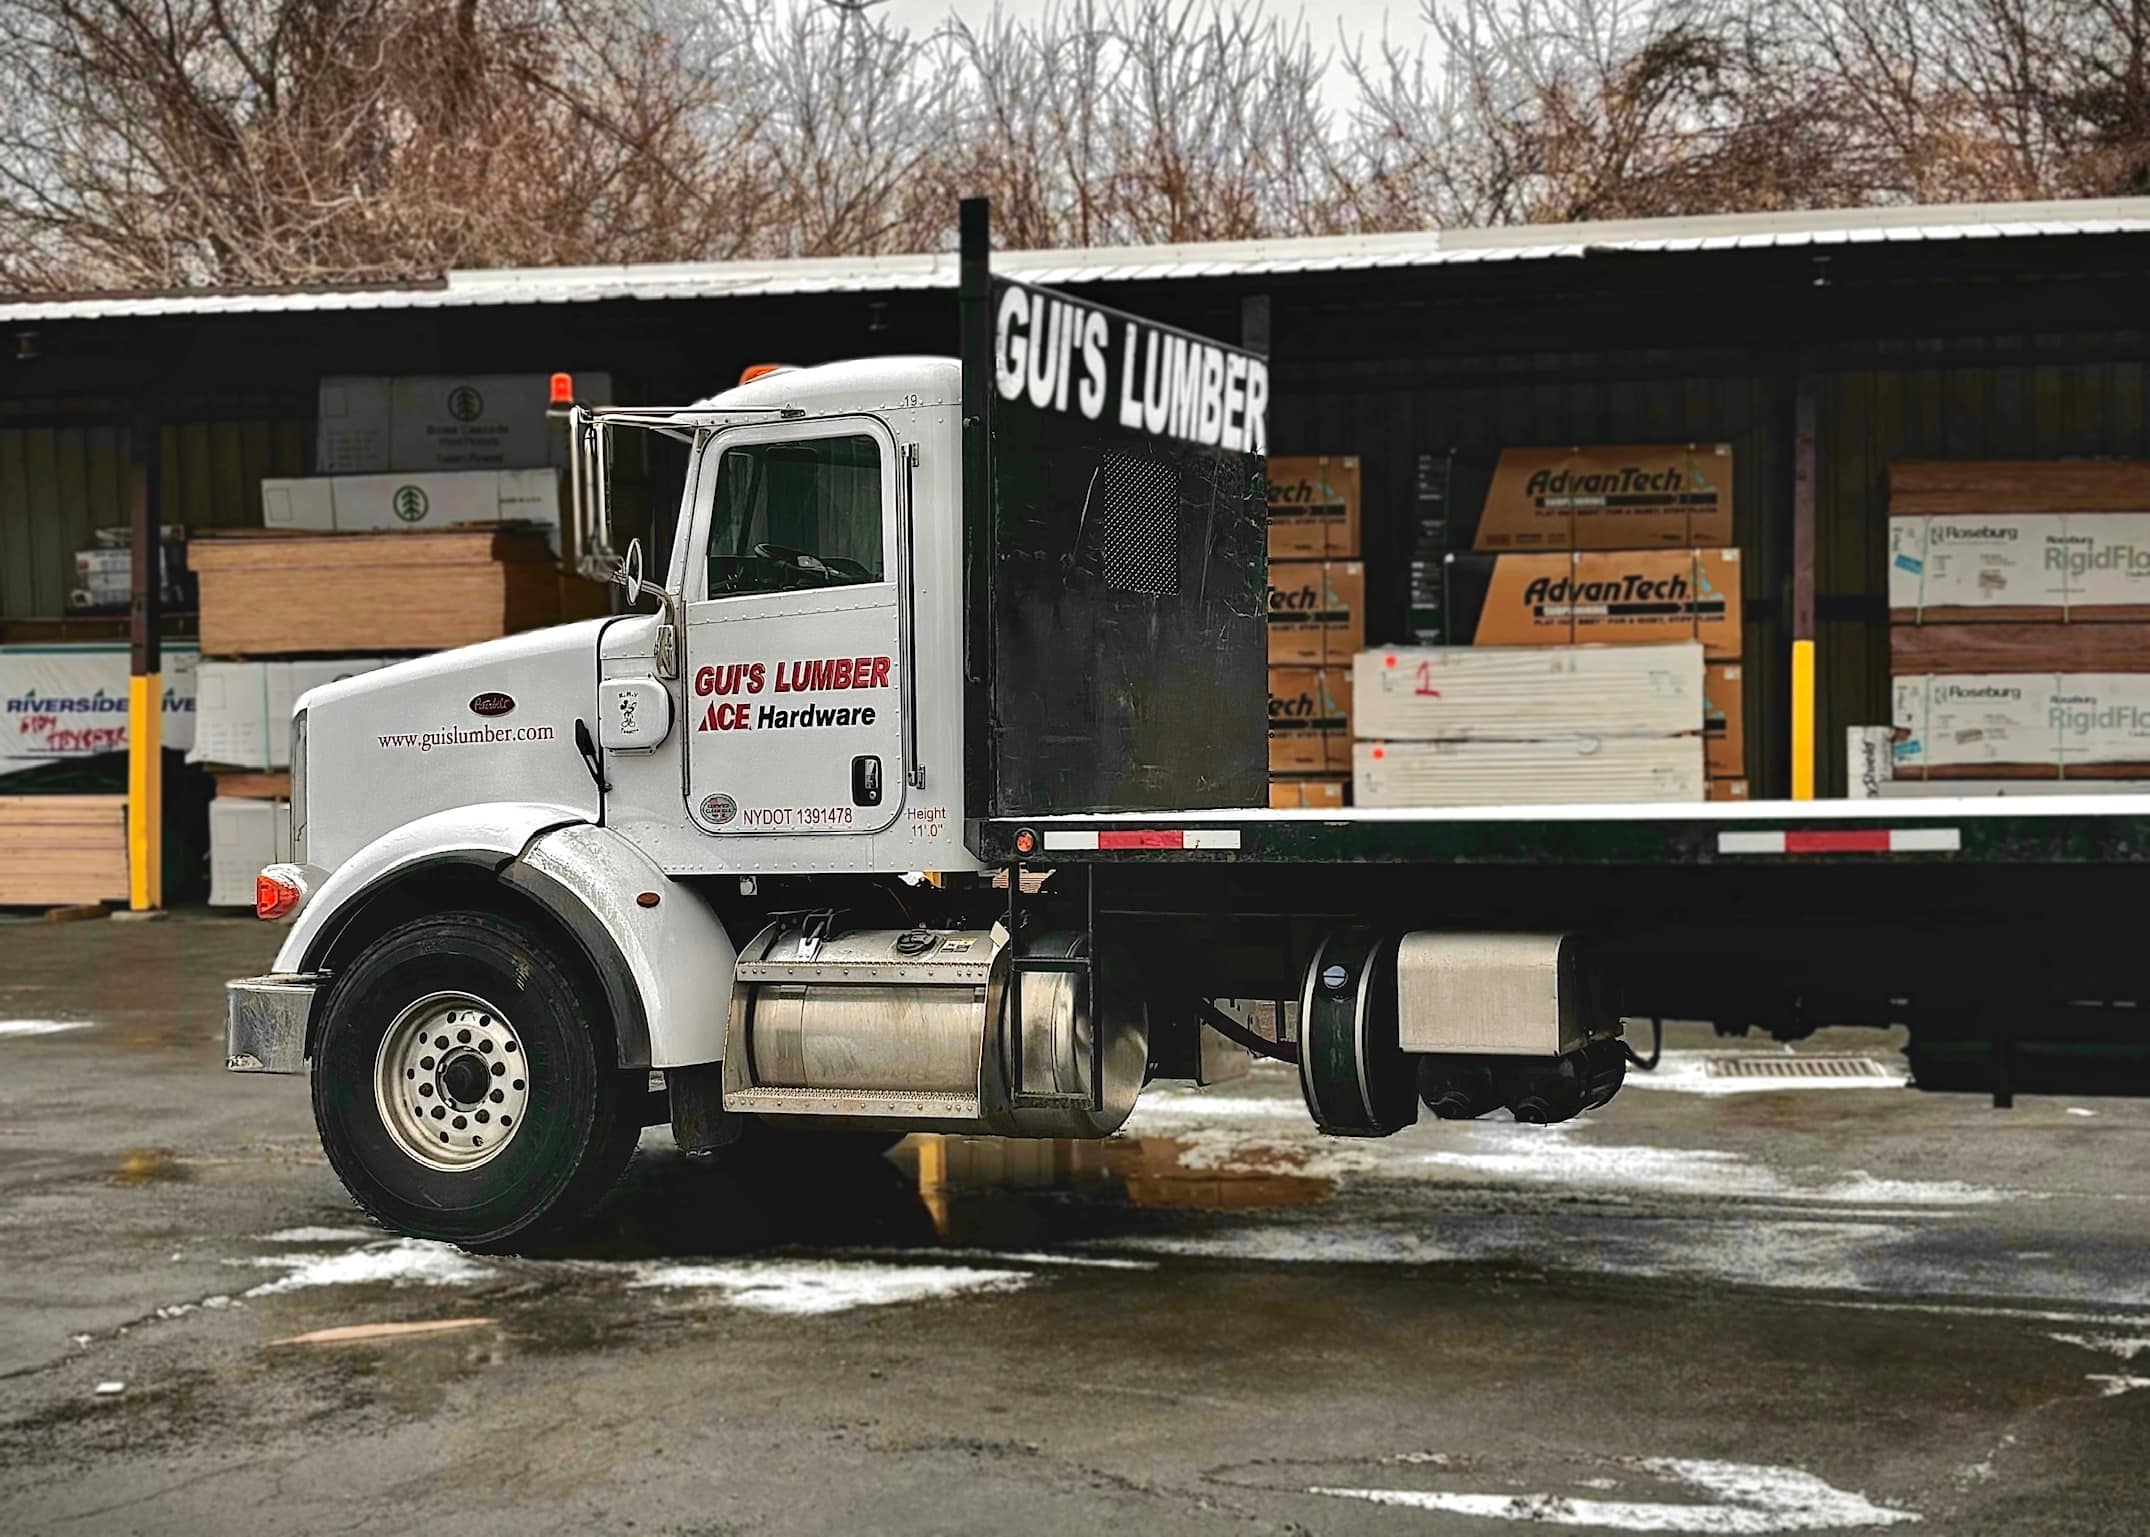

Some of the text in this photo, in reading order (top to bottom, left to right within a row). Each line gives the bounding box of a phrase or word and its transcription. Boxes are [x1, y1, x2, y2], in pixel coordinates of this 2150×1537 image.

[996, 286, 1268, 456] GUI'S LUMBER
[904, 394, 918, 407] 19
[1526, 467, 1682, 496] AdvanTech
[1946, 526, 2018, 541] Roseburg
[1524, 573, 1687, 605] AdvanTech
[695, 656, 891, 696] GUI'S LUMBER
[7, 692, 129, 712] RIVERSIDE
[1950, 685, 2021, 700] Roseburg
[698, 700, 876, 731] ACE Hardware
[378, 724, 554, 751] www.guislumber.com
[743, 807, 853, 825] NYDOT 1391478
[907, 807, 946, 822] Height
